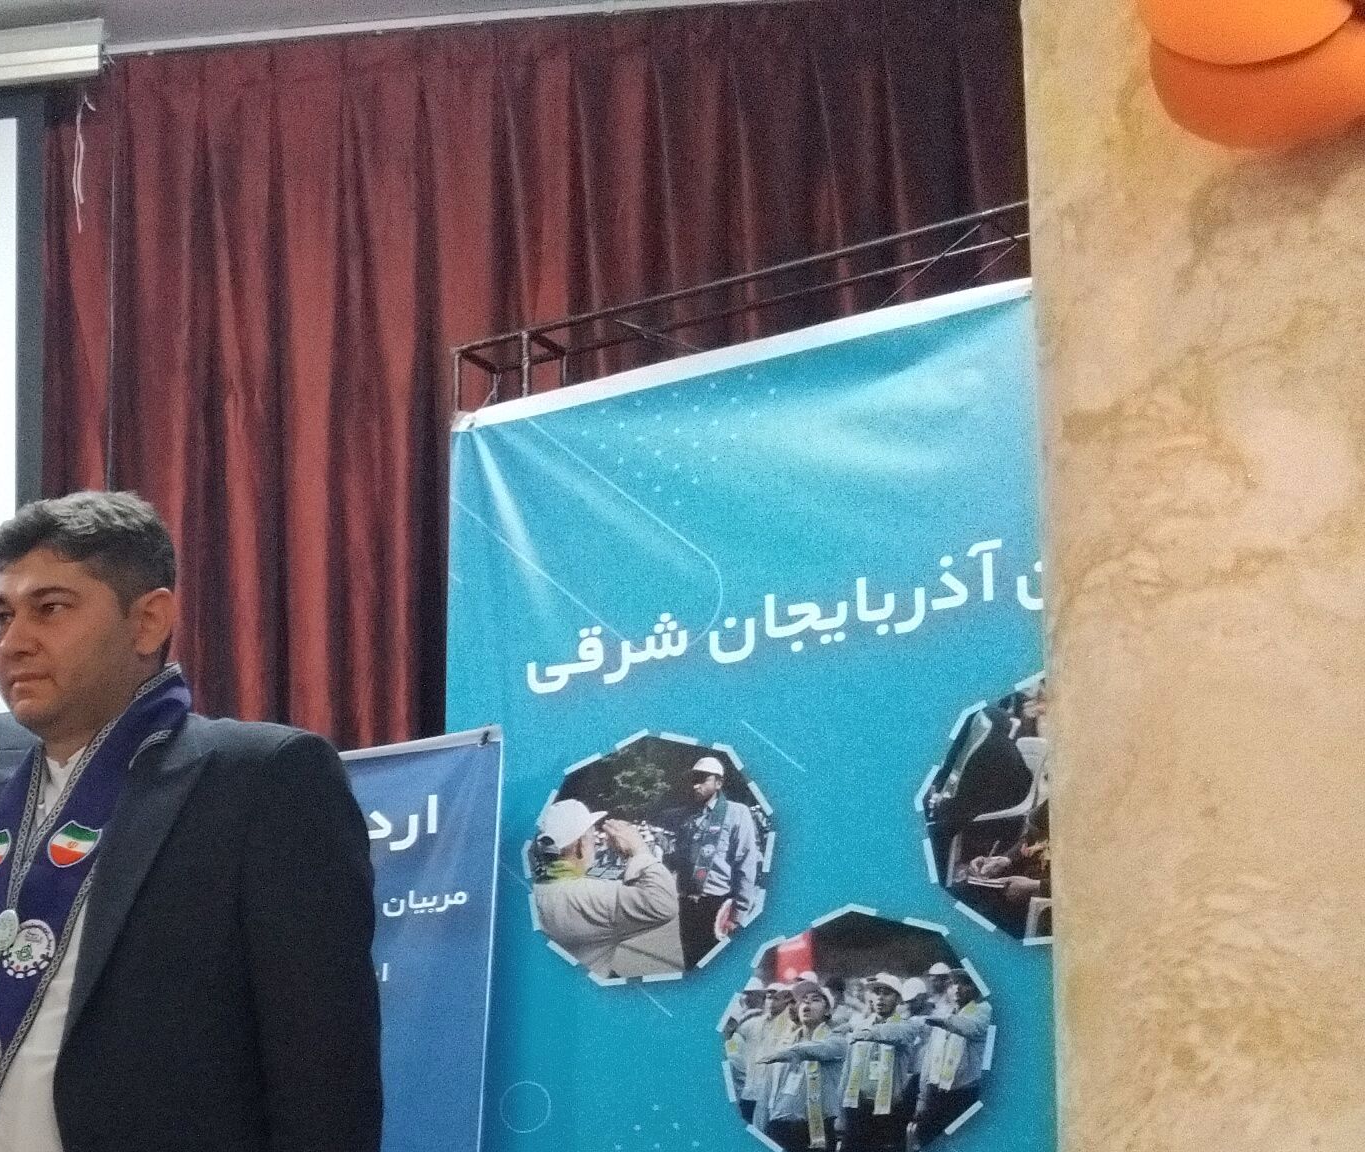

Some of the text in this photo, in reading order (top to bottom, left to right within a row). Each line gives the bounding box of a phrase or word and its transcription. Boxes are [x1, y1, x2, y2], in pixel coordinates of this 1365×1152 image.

[708, 539, 1002, 664] آذربایجان
[526, 612, 689, 695] شرقی
[367, 794, 438, 852] ارد
[382, 888, 468, 918] مربیان
